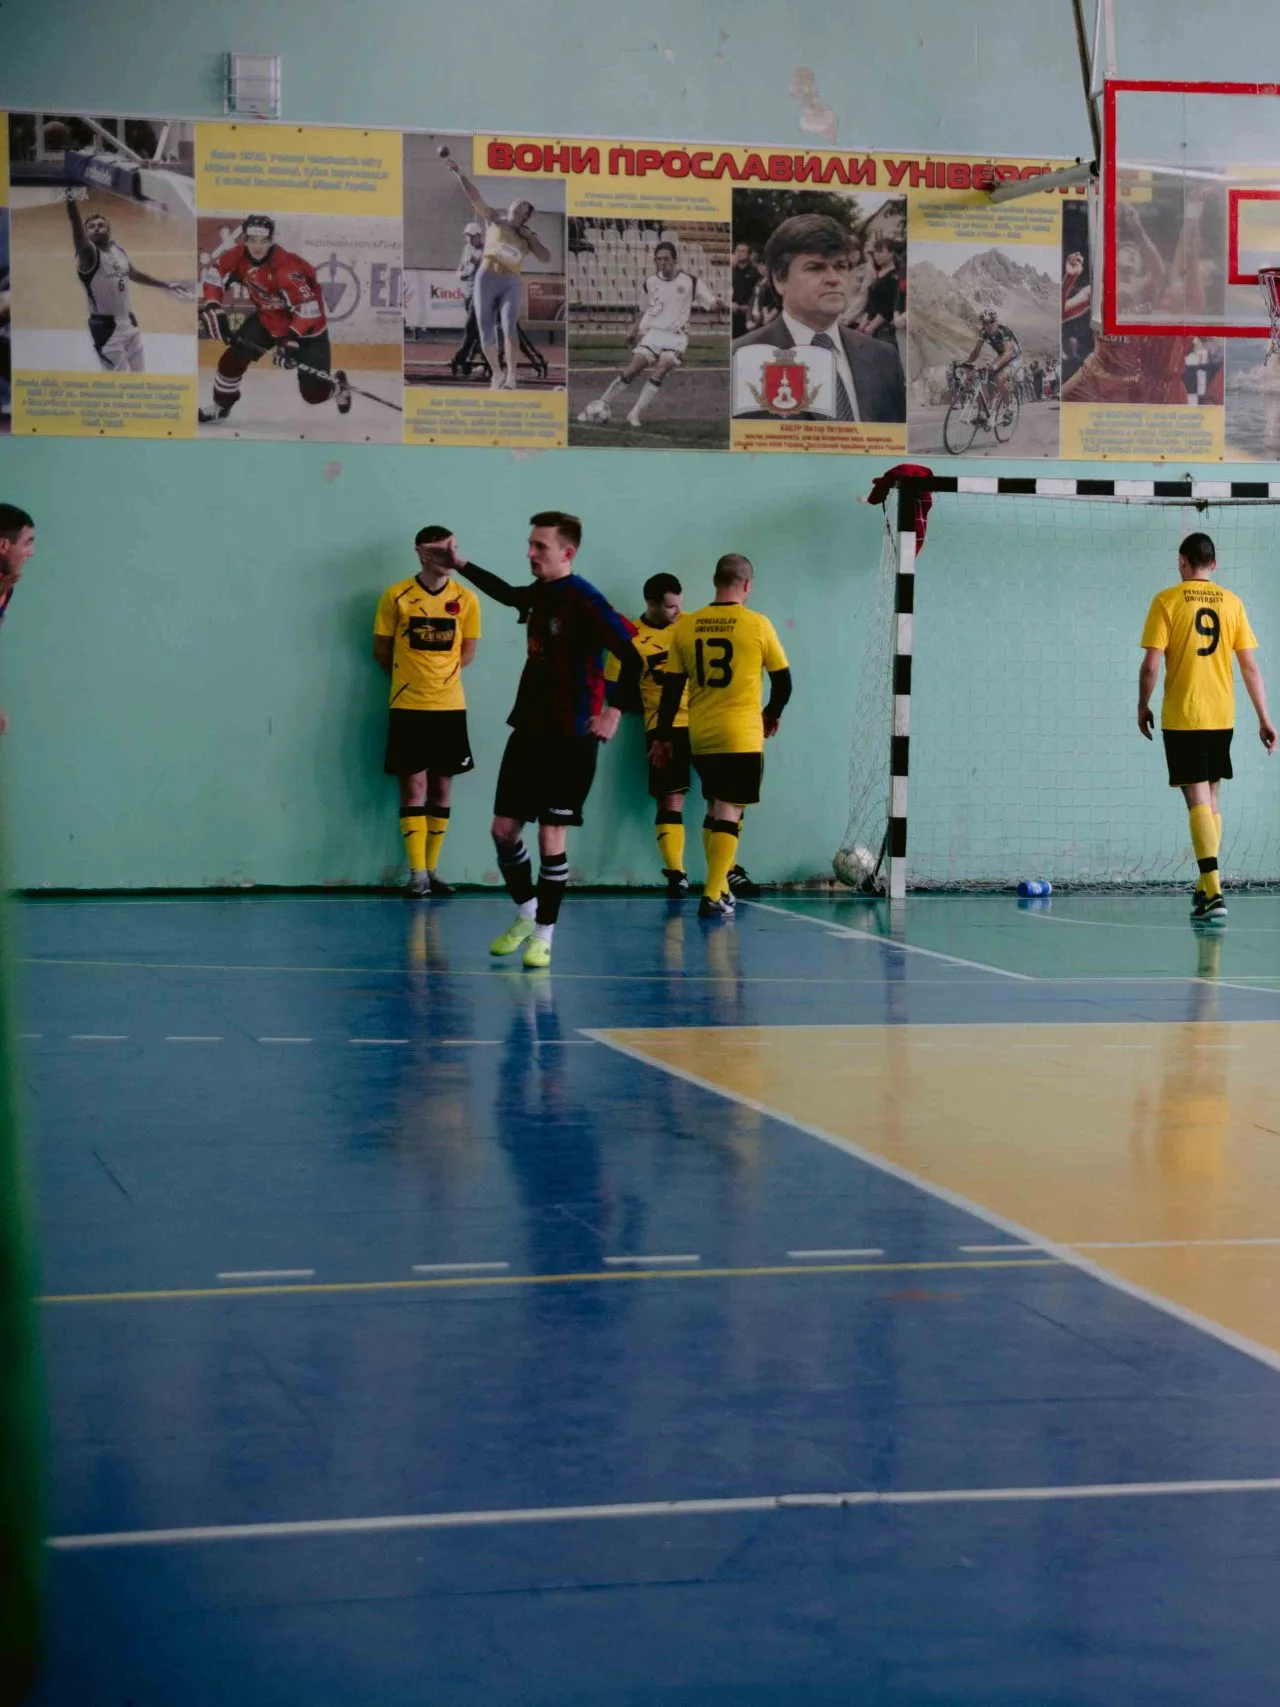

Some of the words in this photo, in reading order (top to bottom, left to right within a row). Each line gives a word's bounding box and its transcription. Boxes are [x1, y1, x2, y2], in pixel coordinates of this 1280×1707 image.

[487, 142, 600, 175] ВОНИ
[608, 147, 877, 185] ПРОСЛАВИЛИ
[1194, 607, 1221, 656] 9
[694, 637, 734, 688] 13
